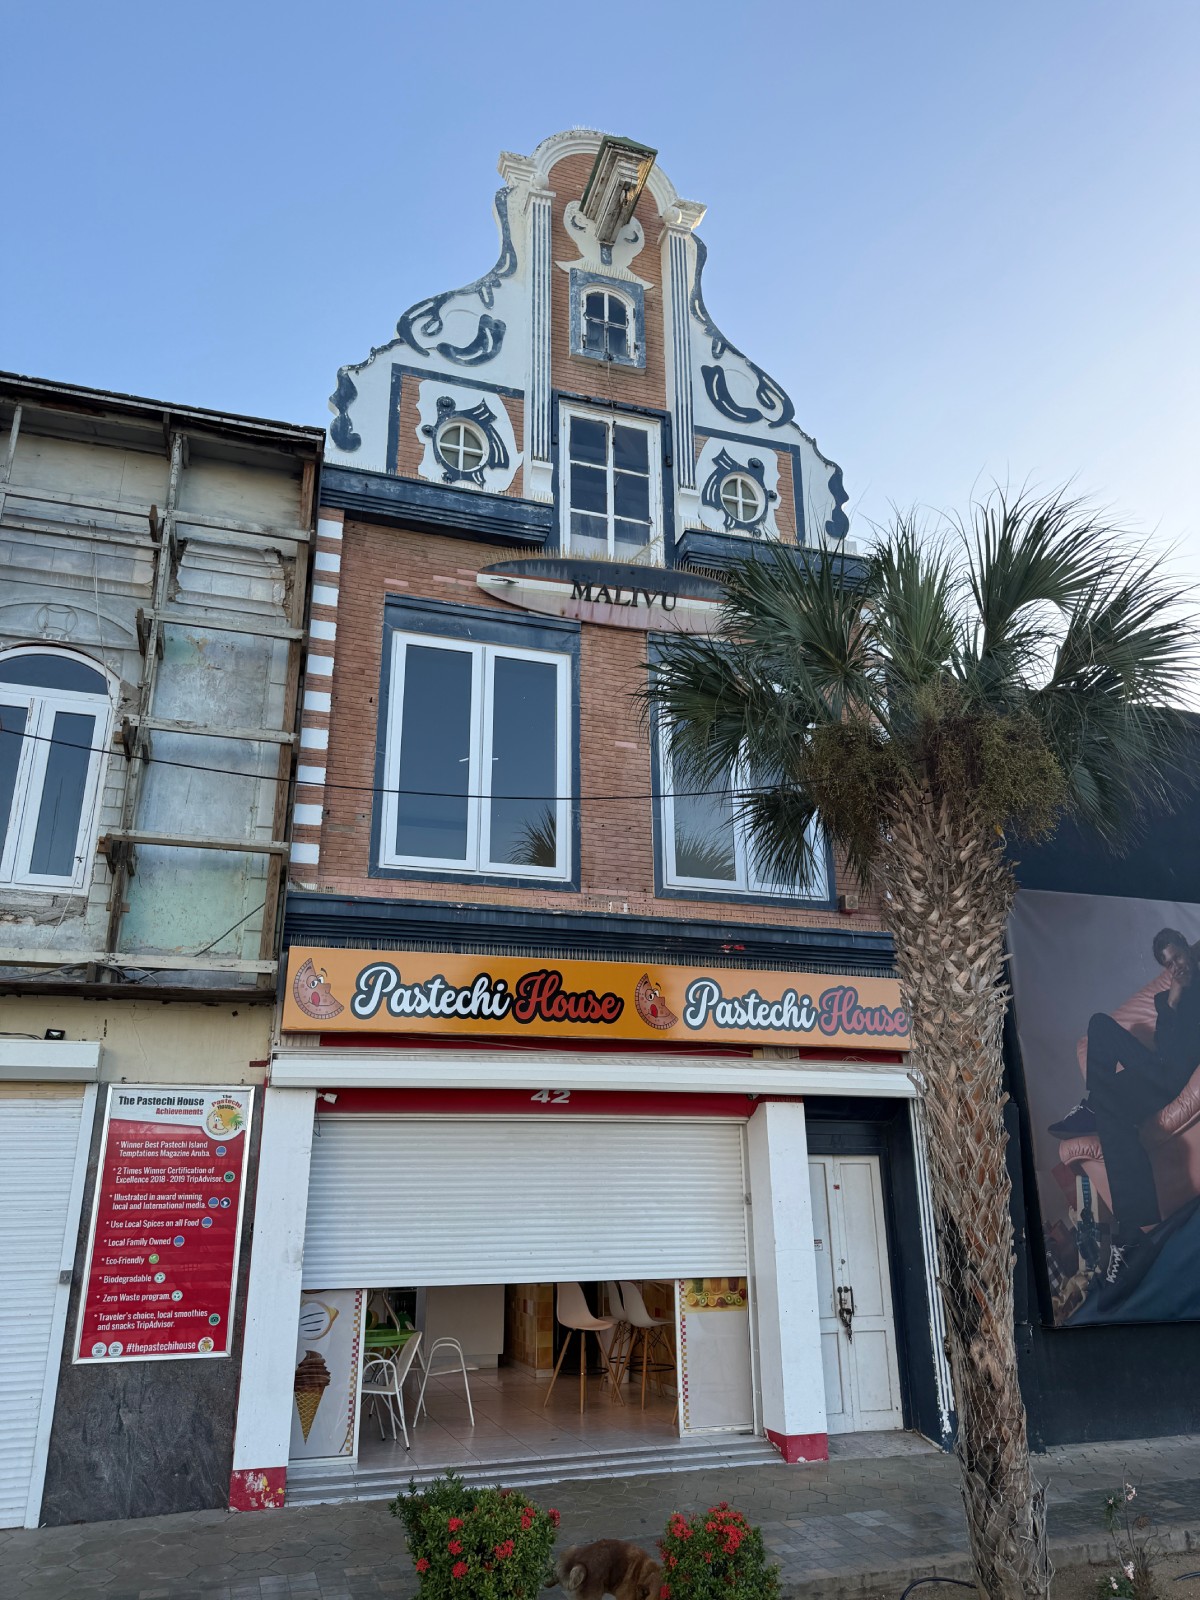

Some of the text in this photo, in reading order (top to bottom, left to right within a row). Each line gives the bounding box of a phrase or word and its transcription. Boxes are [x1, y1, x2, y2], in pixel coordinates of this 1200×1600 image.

[570, 579, 679, 612] MALIVU
[353, 966, 622, 1021] Pastechi House
[685, 980, 908, 1034] Pastechi House
[530, 1089, 571, 1103] 42
[119, 1096, 205, 1106] The Pastechi House
[155, 1107, 204, 1116] Achievements
[120, 1140, 208, 1149] Winner Best Pastechi Island
[119, 1149, 159, 1158] Temptations
[160, 1149, 190, 1158] Magazine
[123, 1167, 142, 1175] Times
[143, 1167, 166, 1175] Winner
[167, 1167, 206, 1175] Certification
[207, 1166, 215, 1174] of
[116, 1175, 150, 1184] Excellence
[150, 1175, 166, 1183] 2018
[169, 1175, 185, 1183] 2019
[113, 1193, 203, 1201] Illustrated in award winning
[112, 1202, 129, 1210] local
[129, 1202, 142, 1210] and
[143, 1202, 185, 1210] International
[110, 1220, 124, 1228] Use
[124, 1220, 141, 1228] Local
[142, 1219, 164, 1229] Spices
[174, 1219, 183, 1227] all
[184, 1218, 200, 1227] Food
[108, 1237, 171, 1247] Local Family Owned
[105, 1256, 145, 1265] Eco-Friendly
[103, 1275, 152, 1284] Biodegradable
[102, 1294, 118, 1302] Zero
[119, 1293, 141, 1301] Waste
[99, 1312, 132, 1321] Traveler's
[157, 1310, 173, 1319] local
[174, 1309, 208, 1318] smoothies
[97, 1323, 111, 1331] and
[111, 1322, 135, 1330] snacks
[126, 1341, 196, 1353] #thepastechihouse
